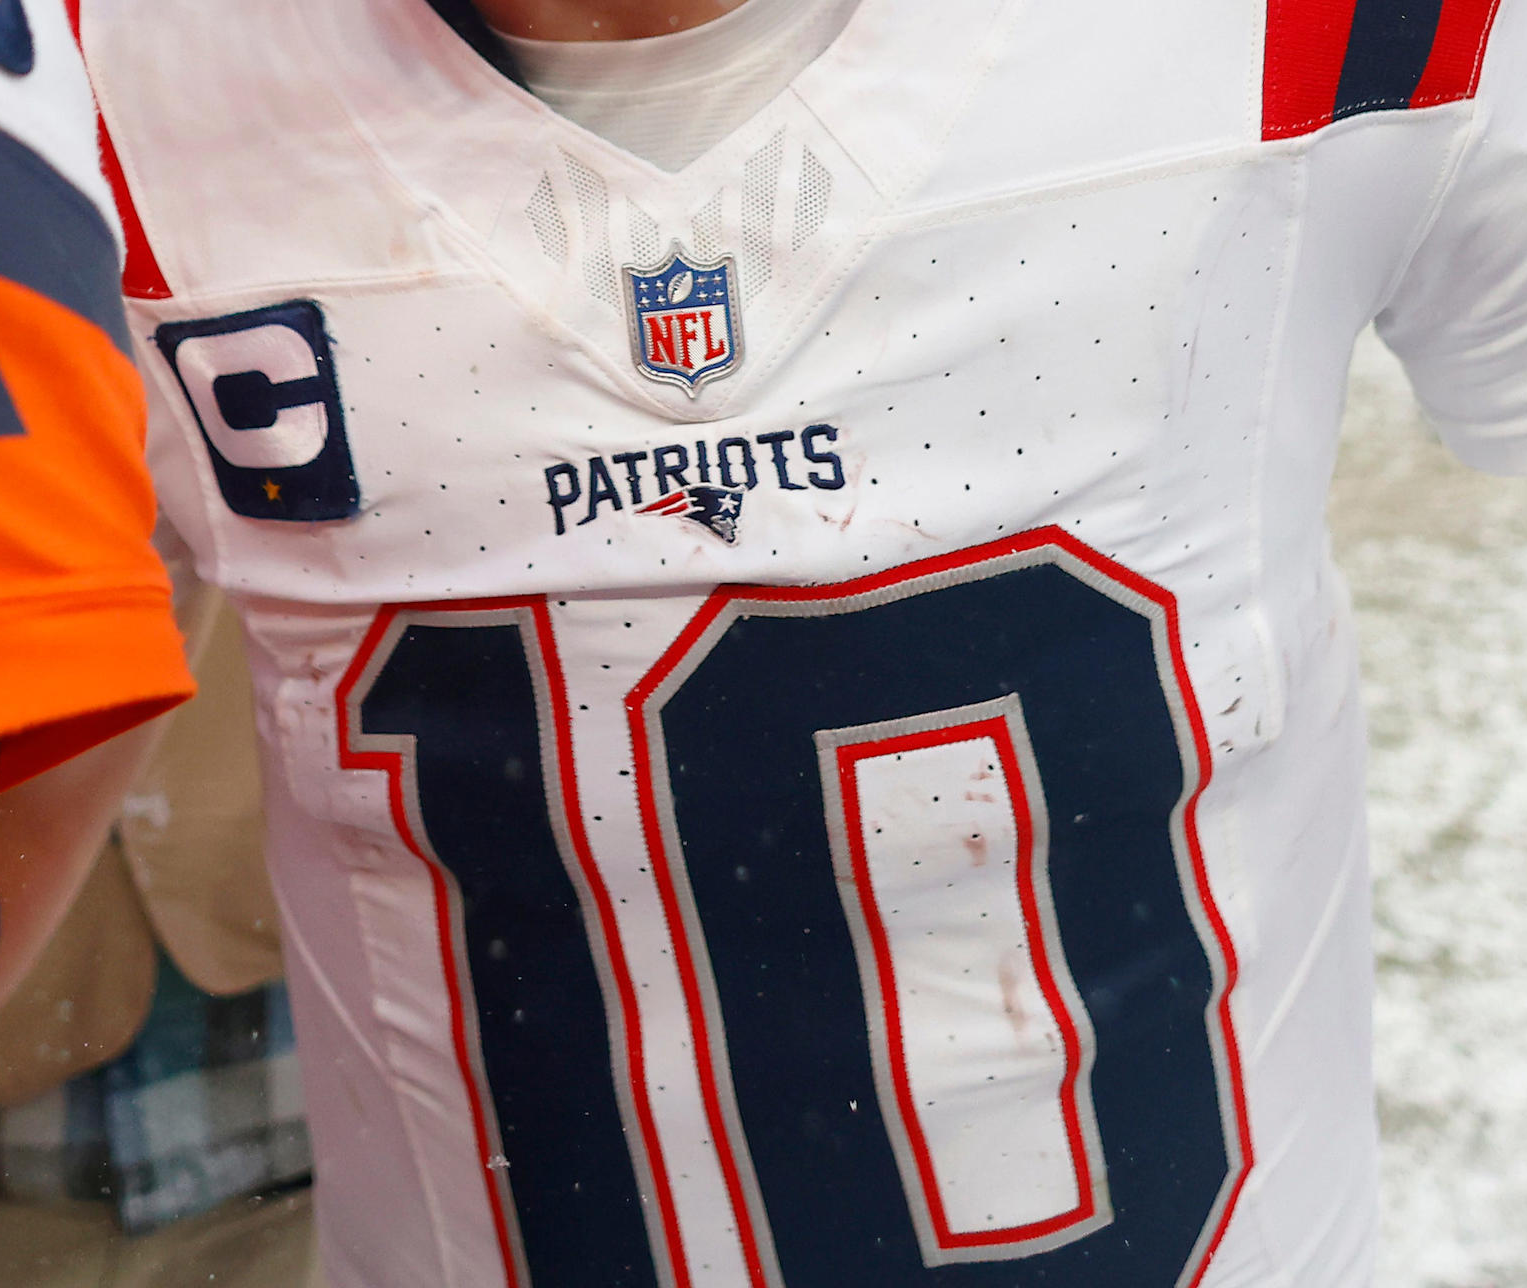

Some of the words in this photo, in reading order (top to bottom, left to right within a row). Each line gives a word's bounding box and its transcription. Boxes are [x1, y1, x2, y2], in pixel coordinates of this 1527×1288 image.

[175, 322, 330, 469] C
[645, 310, 726, 370] NFL
[544, 423, 846, 536] PATRIOTS
[335, 523, 1253, 1288] 10
